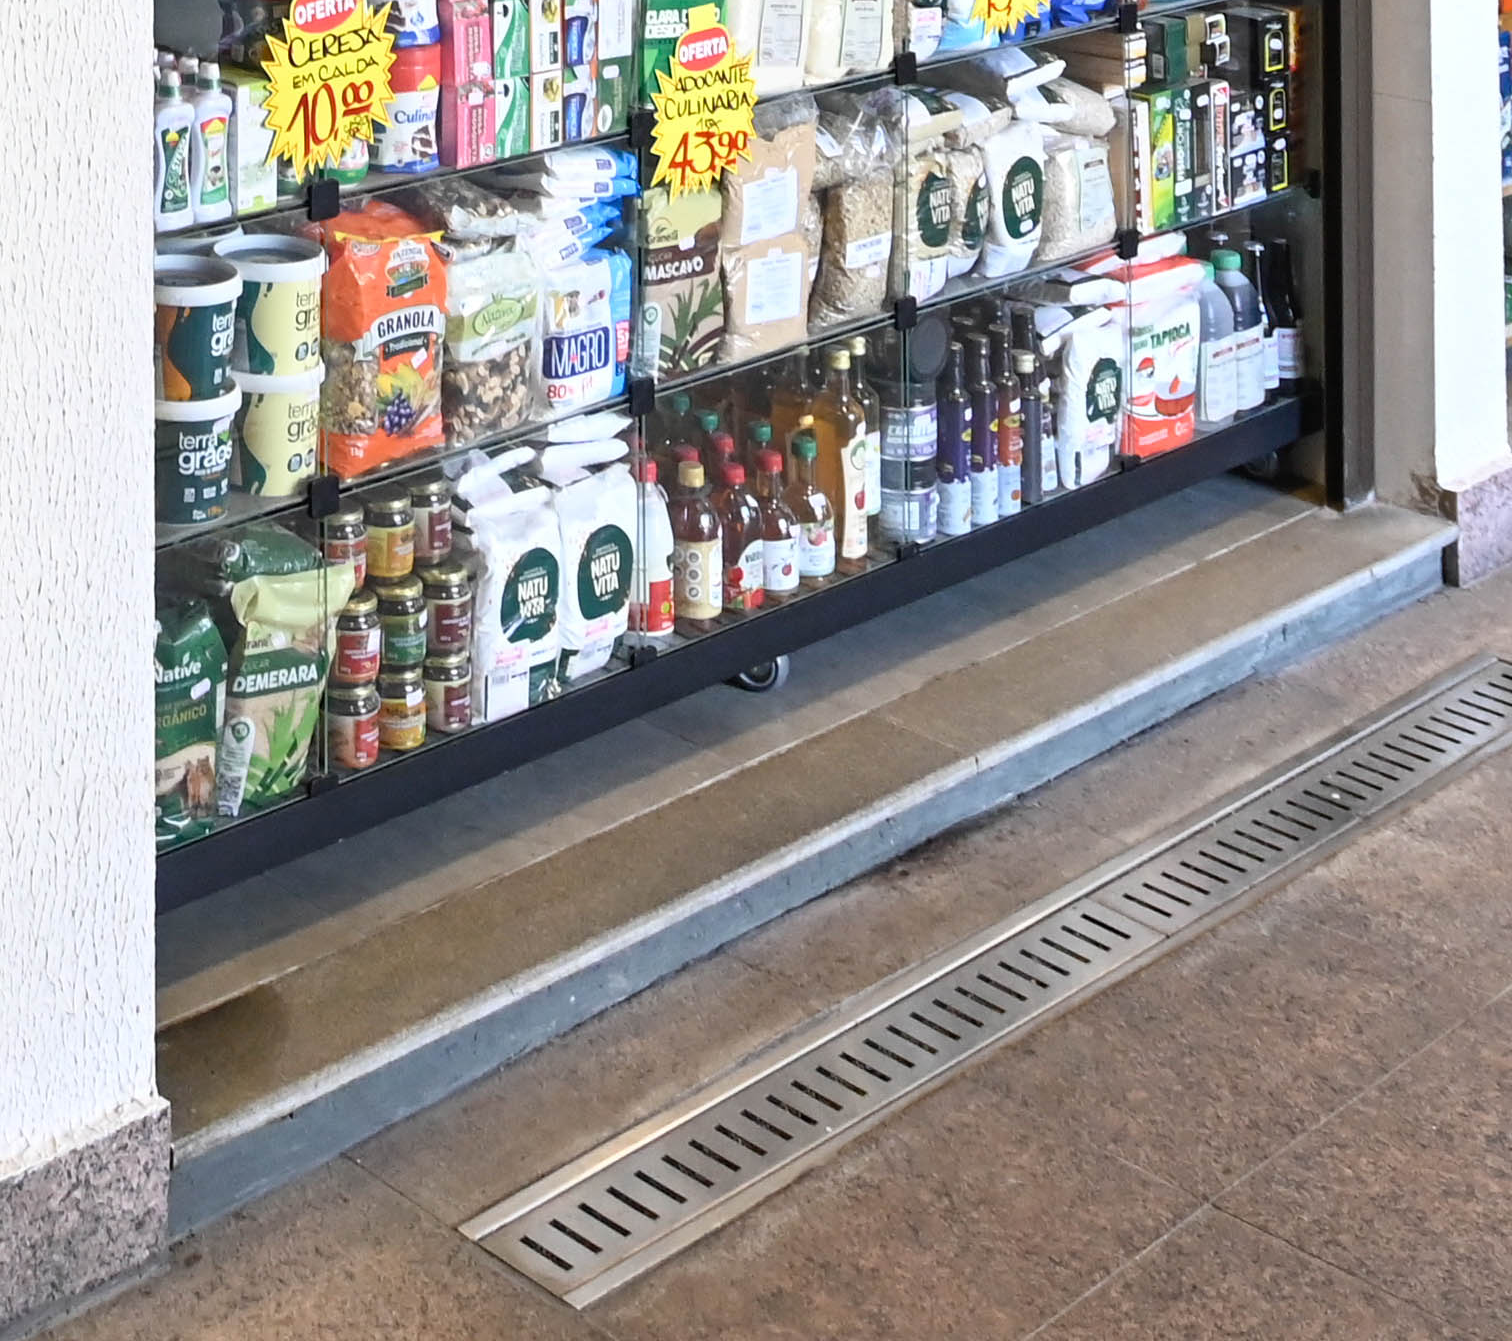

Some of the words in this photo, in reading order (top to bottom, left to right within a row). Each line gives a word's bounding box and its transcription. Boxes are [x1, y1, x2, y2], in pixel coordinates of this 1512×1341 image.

[288, 28, 383, 69] CEREJA
[678, 35, 729, 64] OFERTA
[293, 72, 316, 90] EM
[318, 56, 380, 82] CALDA
[675, 64, 749, 94] ADOCANTE
[1011, 177, 1036, 200] NATU
[930, 205, 951, 225] VITA
[1015, 195, 1036, 219] VITA
[644, 255, 705, 281] MASCAVO
[377, 310, 436, 339] GRANOLA
[1150, 321, 1191, 350] TAPIOCA
[551, 330, 606, 378] MAGRO
[178, 429, 219, 451] terra
[178, 438, 233, 476] grãos
[590, 551, 621, 579] NATU
[517, 575, 549, 601] NATU
[592, 572, 620, 598] VITA
[232, 663, 319, 694] DEMERARA
[157, 703, 208, 728] RGÂNICO
